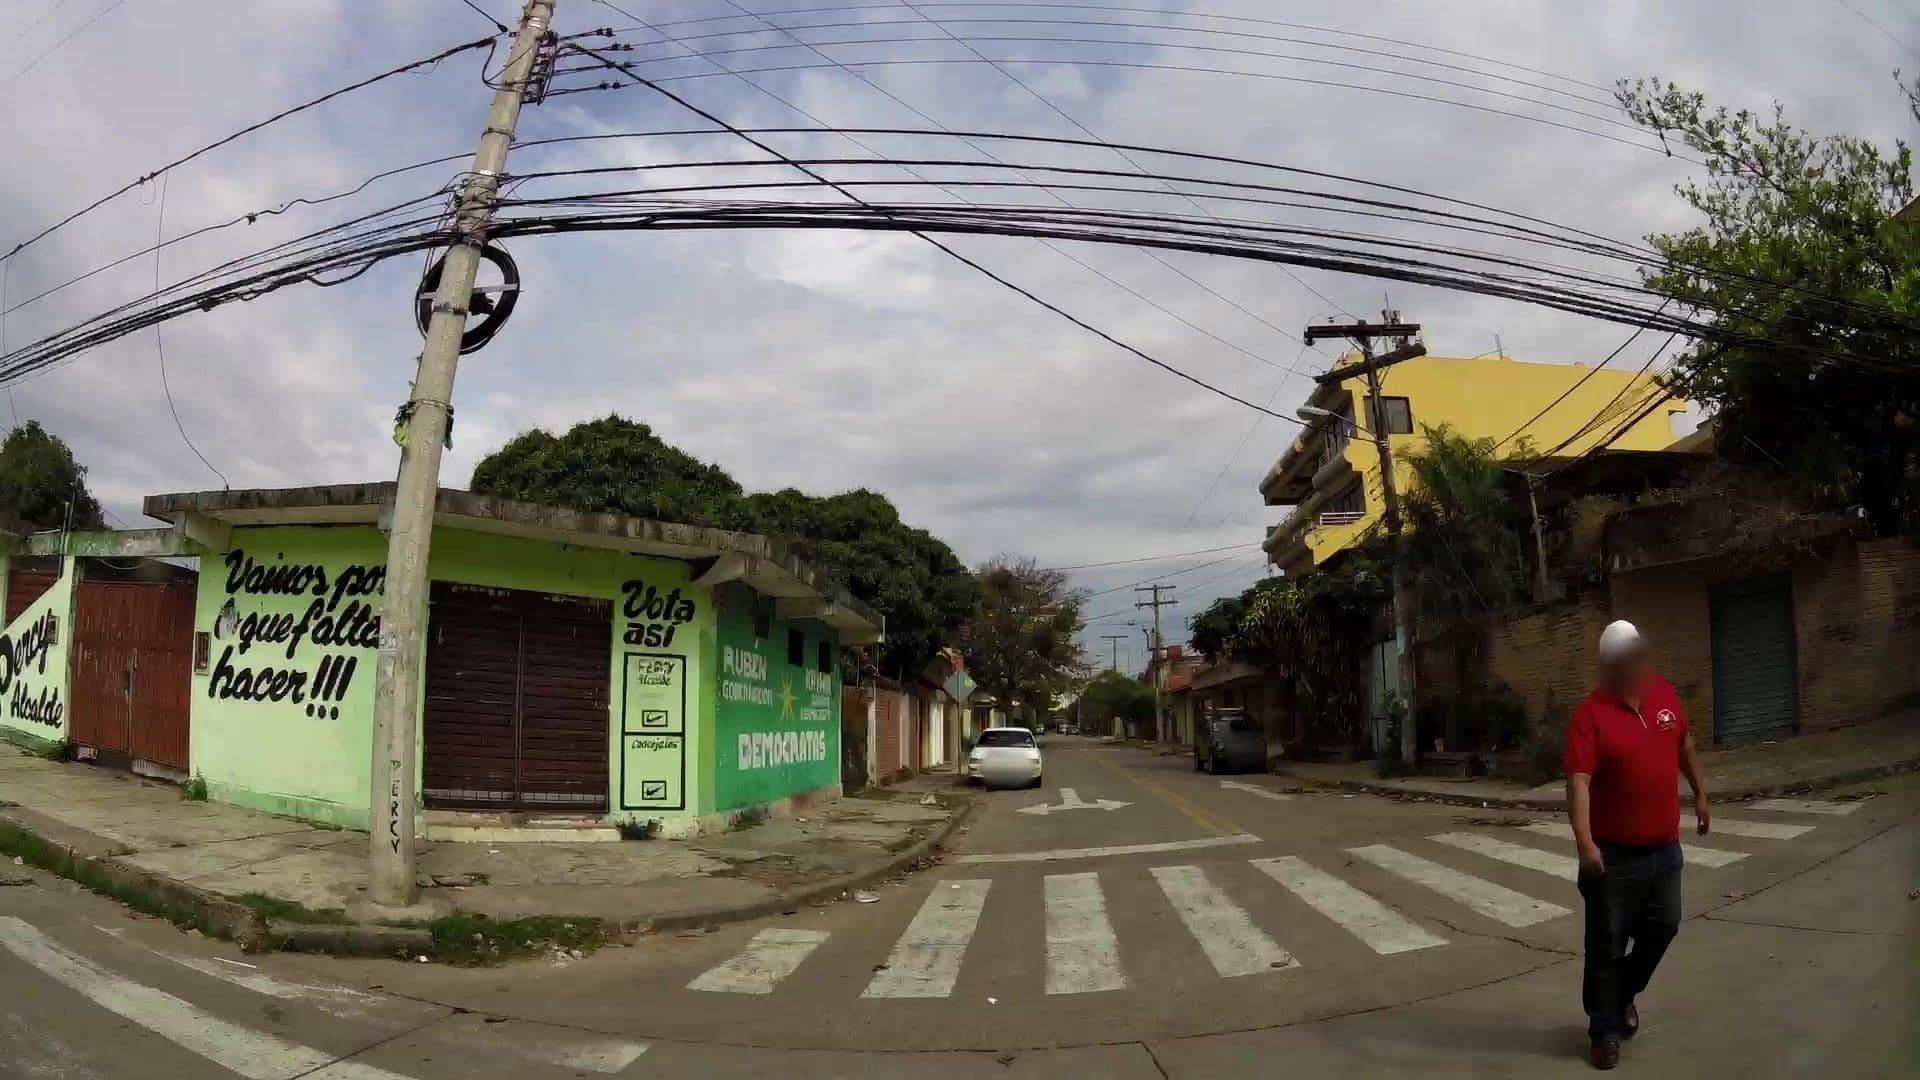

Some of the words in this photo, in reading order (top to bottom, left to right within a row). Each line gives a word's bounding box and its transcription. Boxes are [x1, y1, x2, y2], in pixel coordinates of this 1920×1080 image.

[621, 579, 696, 623] Vota
[239, 612, 294, 655] que
[11, 680, 64, 729] Alcalde
